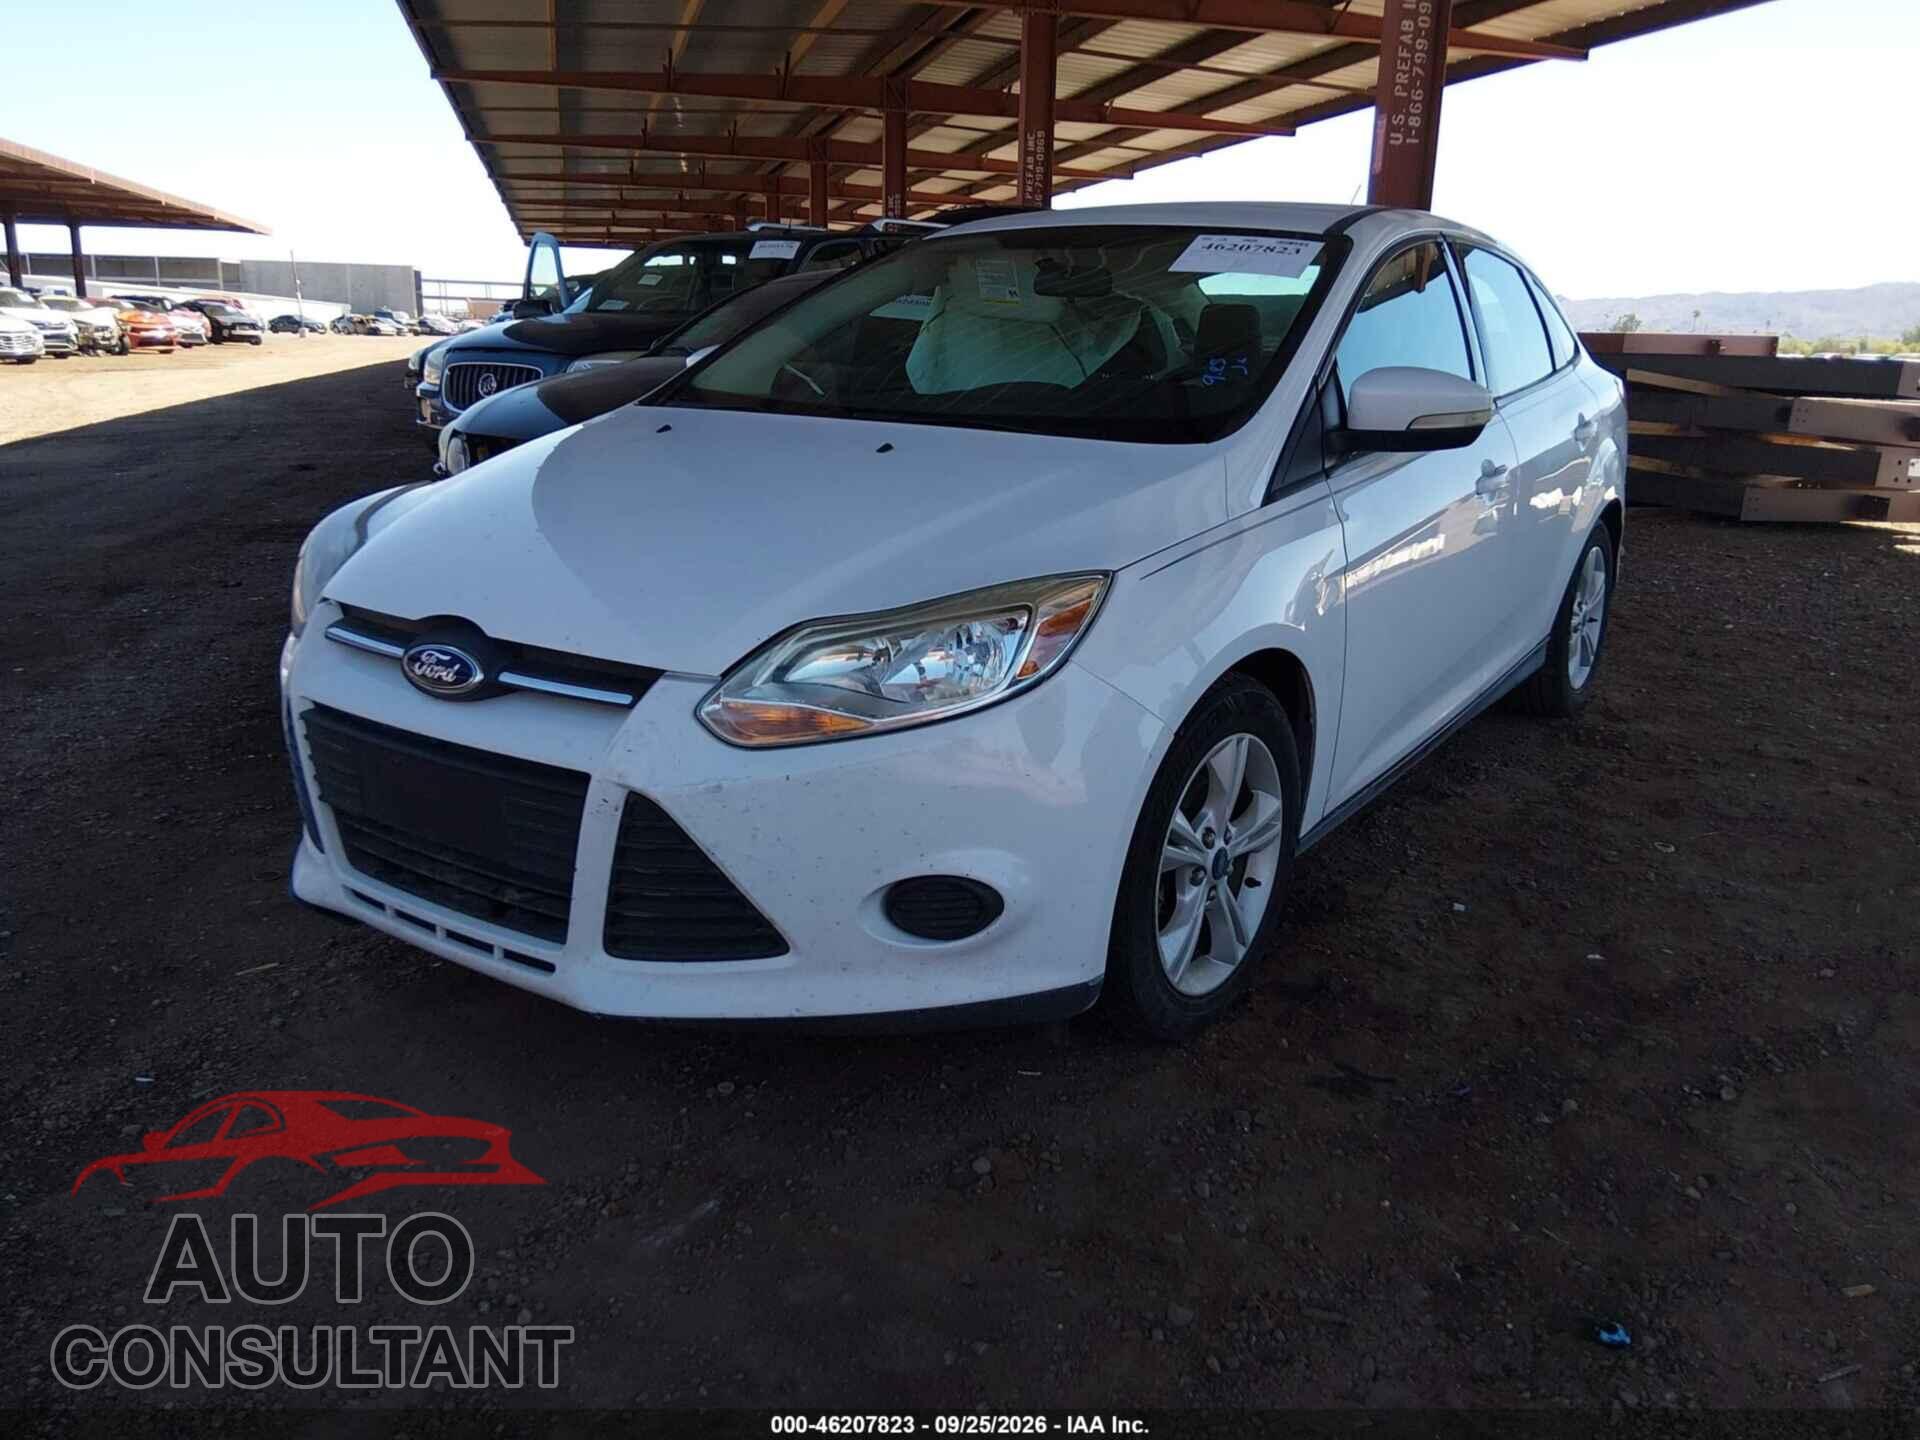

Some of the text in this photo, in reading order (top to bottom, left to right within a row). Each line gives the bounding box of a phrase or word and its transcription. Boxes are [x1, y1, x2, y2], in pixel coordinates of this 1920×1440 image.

[1394, 19, 1415, 97] PREFAB
[1406, 1, 1433, 144] 1-866-799-09
[413, 650, 461, 683] Ford
